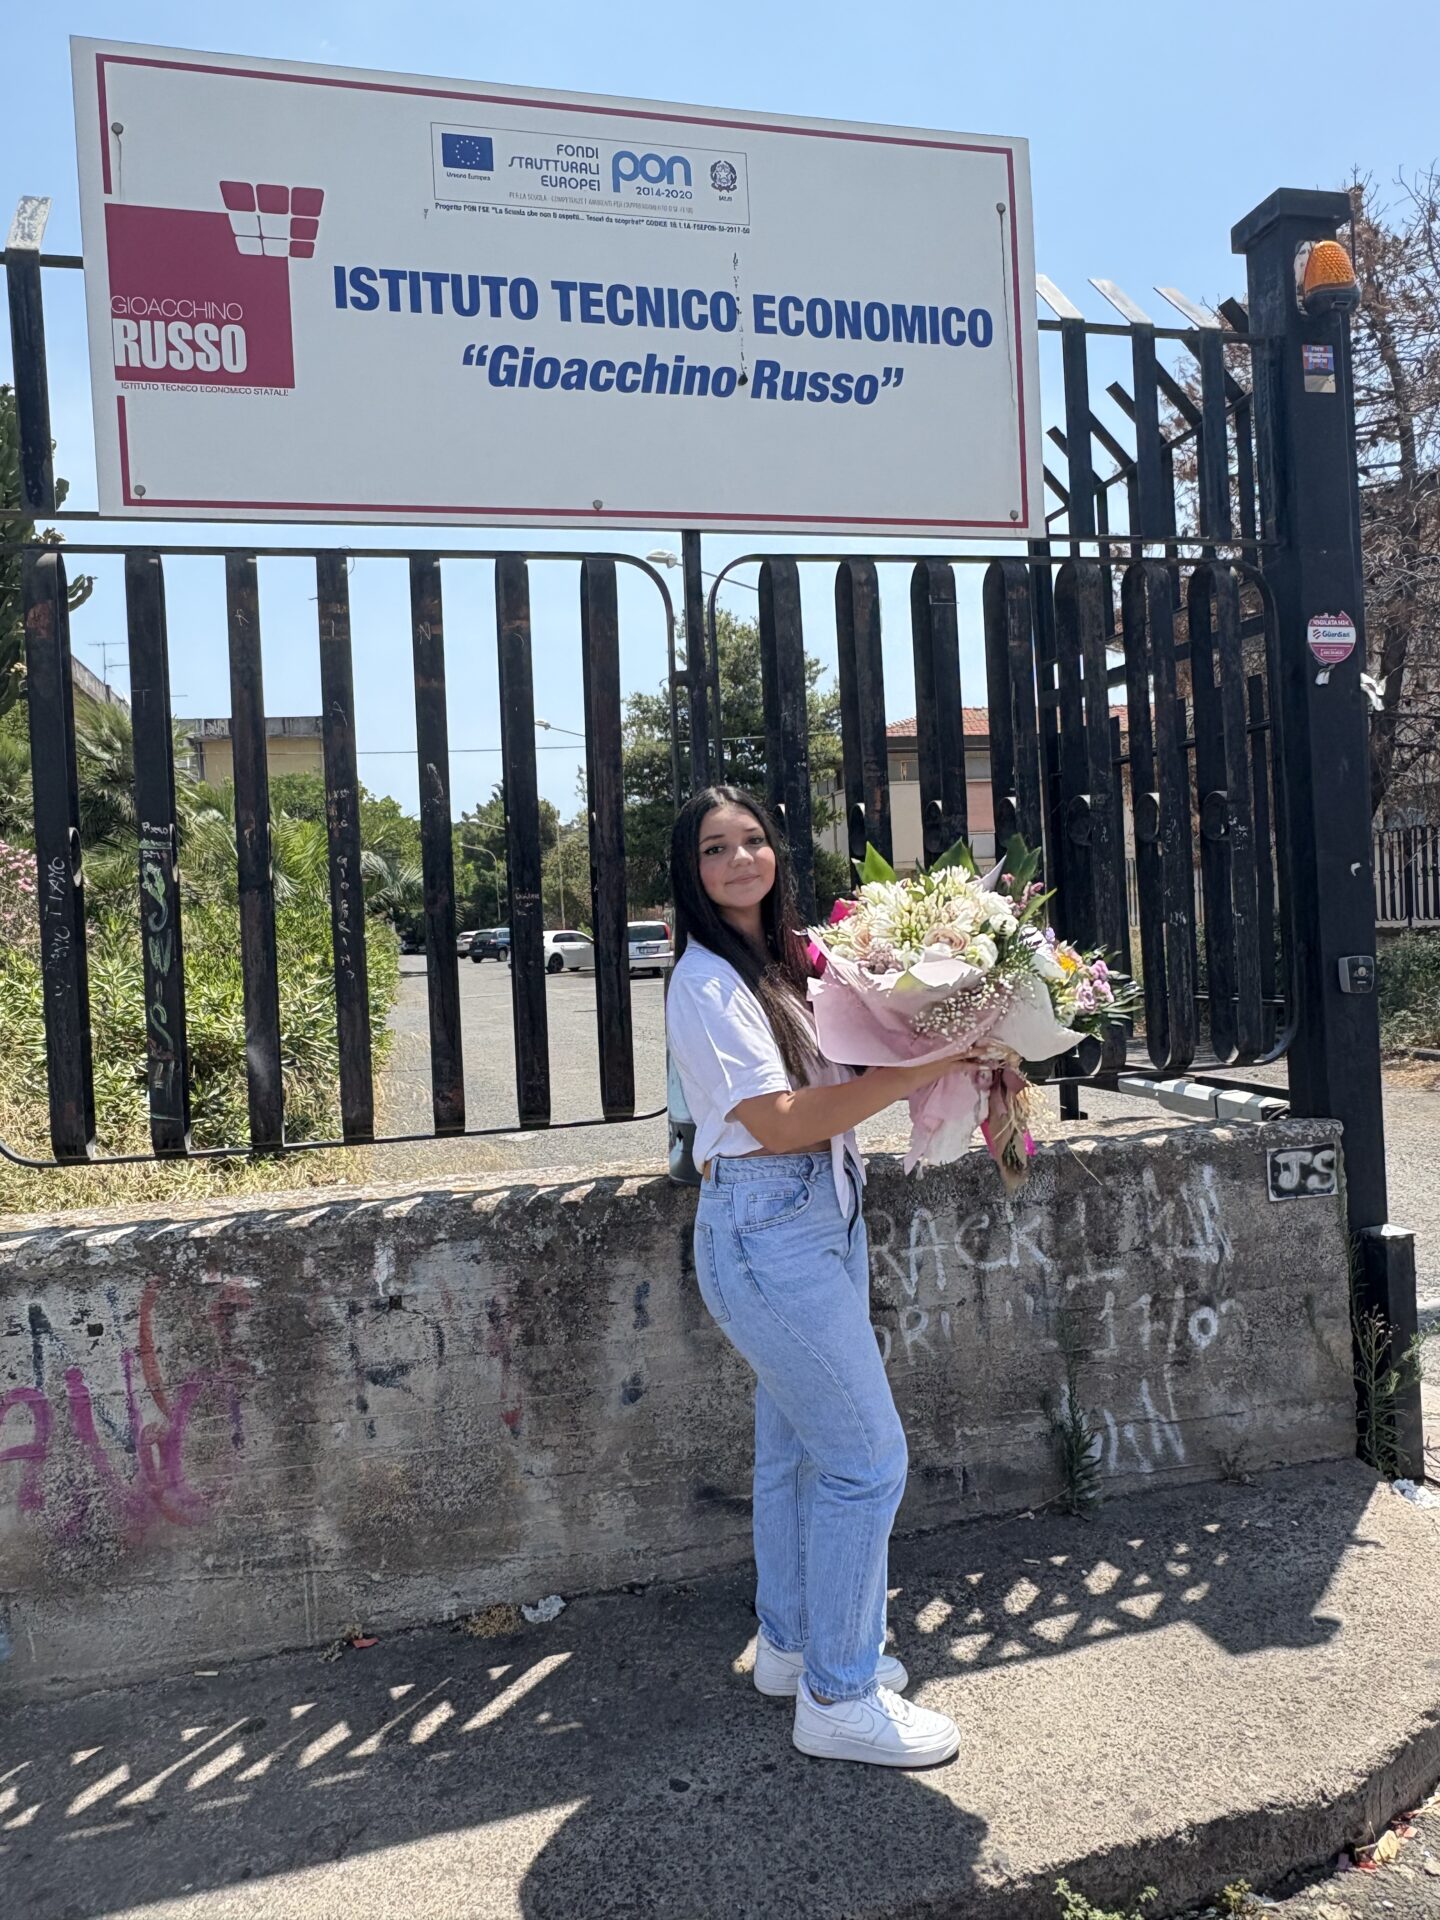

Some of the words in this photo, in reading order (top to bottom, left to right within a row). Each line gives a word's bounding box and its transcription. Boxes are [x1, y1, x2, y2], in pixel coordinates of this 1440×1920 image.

[557, 144, 599, 159] FONDI
[508, 156, 600, 175] STRUTTURALI
[611, 150, 692, 193] pon
[540, 175, 601, 192] EUROPEI
[635, 186, 693, 200] 2014-2020
[110, 295, 243, 321] GIOACCHINO
[333, 265, 539, 321] ISTITUTO
[550, 280, 738, 333] TECNICO
[752, 293, 993, 348] ECONOMICO
[112, 318, 248, 374] RUSSO
[462, 344, 738, 398] “Gioacchino
[750, 359, 904, 405] Russo”
[121, 382, 159, 391] ISTITUTO
[161, 384, 198, 393] TECNICO
[200, 386, 252, 395] ECONOMICO
[253, 388, 289, 397] STATALE
